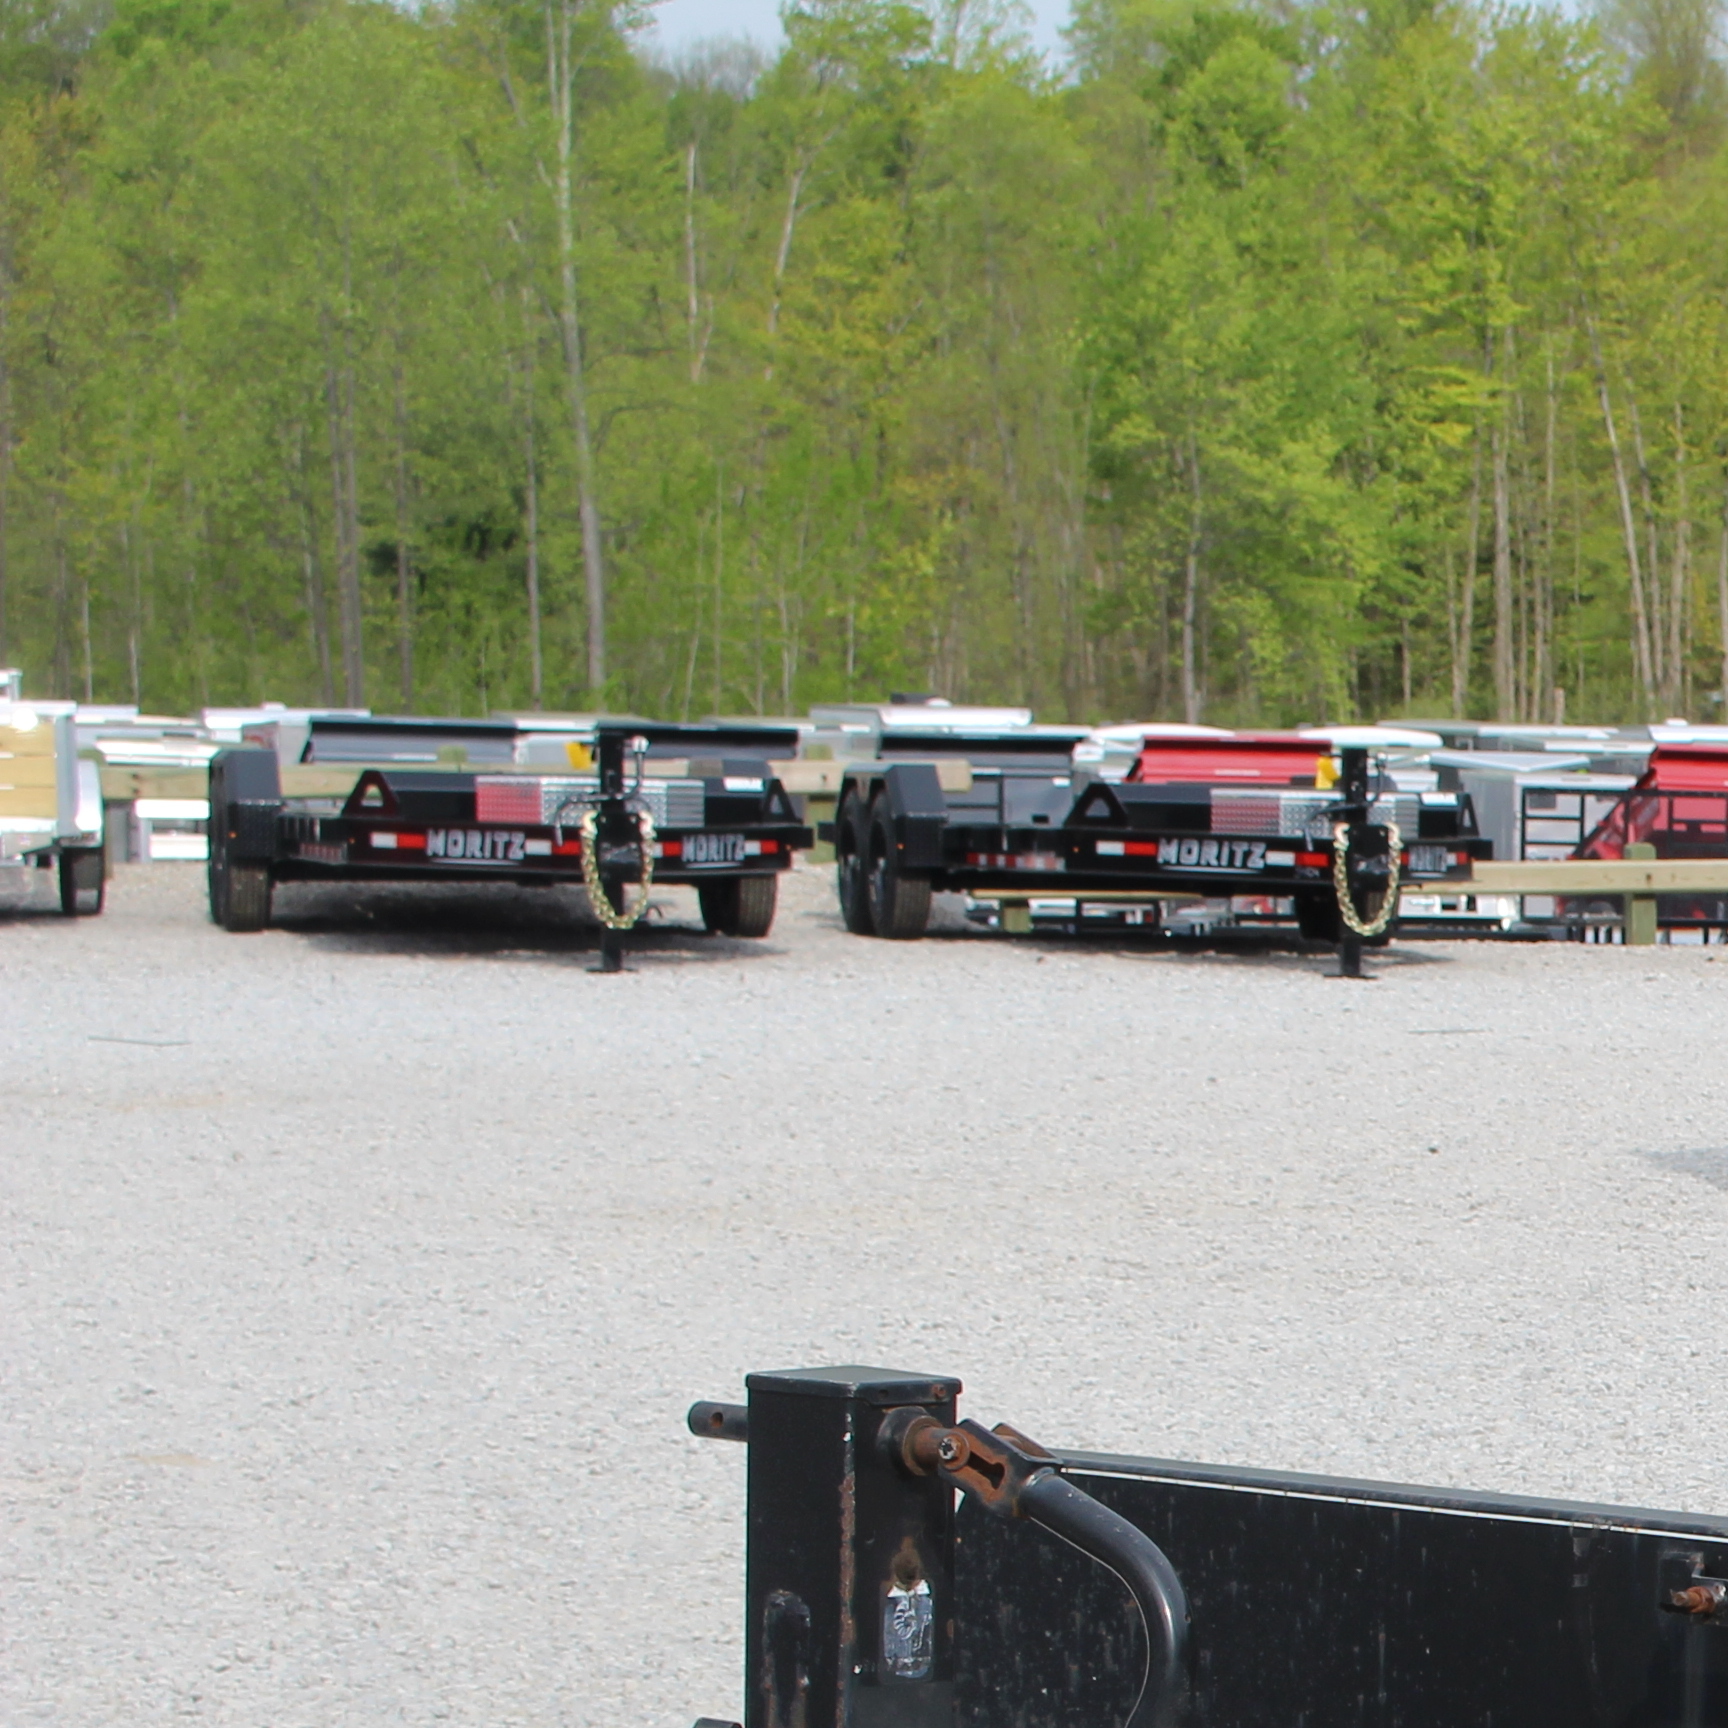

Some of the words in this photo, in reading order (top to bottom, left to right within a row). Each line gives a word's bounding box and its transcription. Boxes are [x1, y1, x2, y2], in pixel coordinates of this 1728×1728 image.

[425, 828, 526, 860] MORITZ
[681, 834, 746, 862] MORITZ
[1156, 838, 1267, 870] MORITZ
